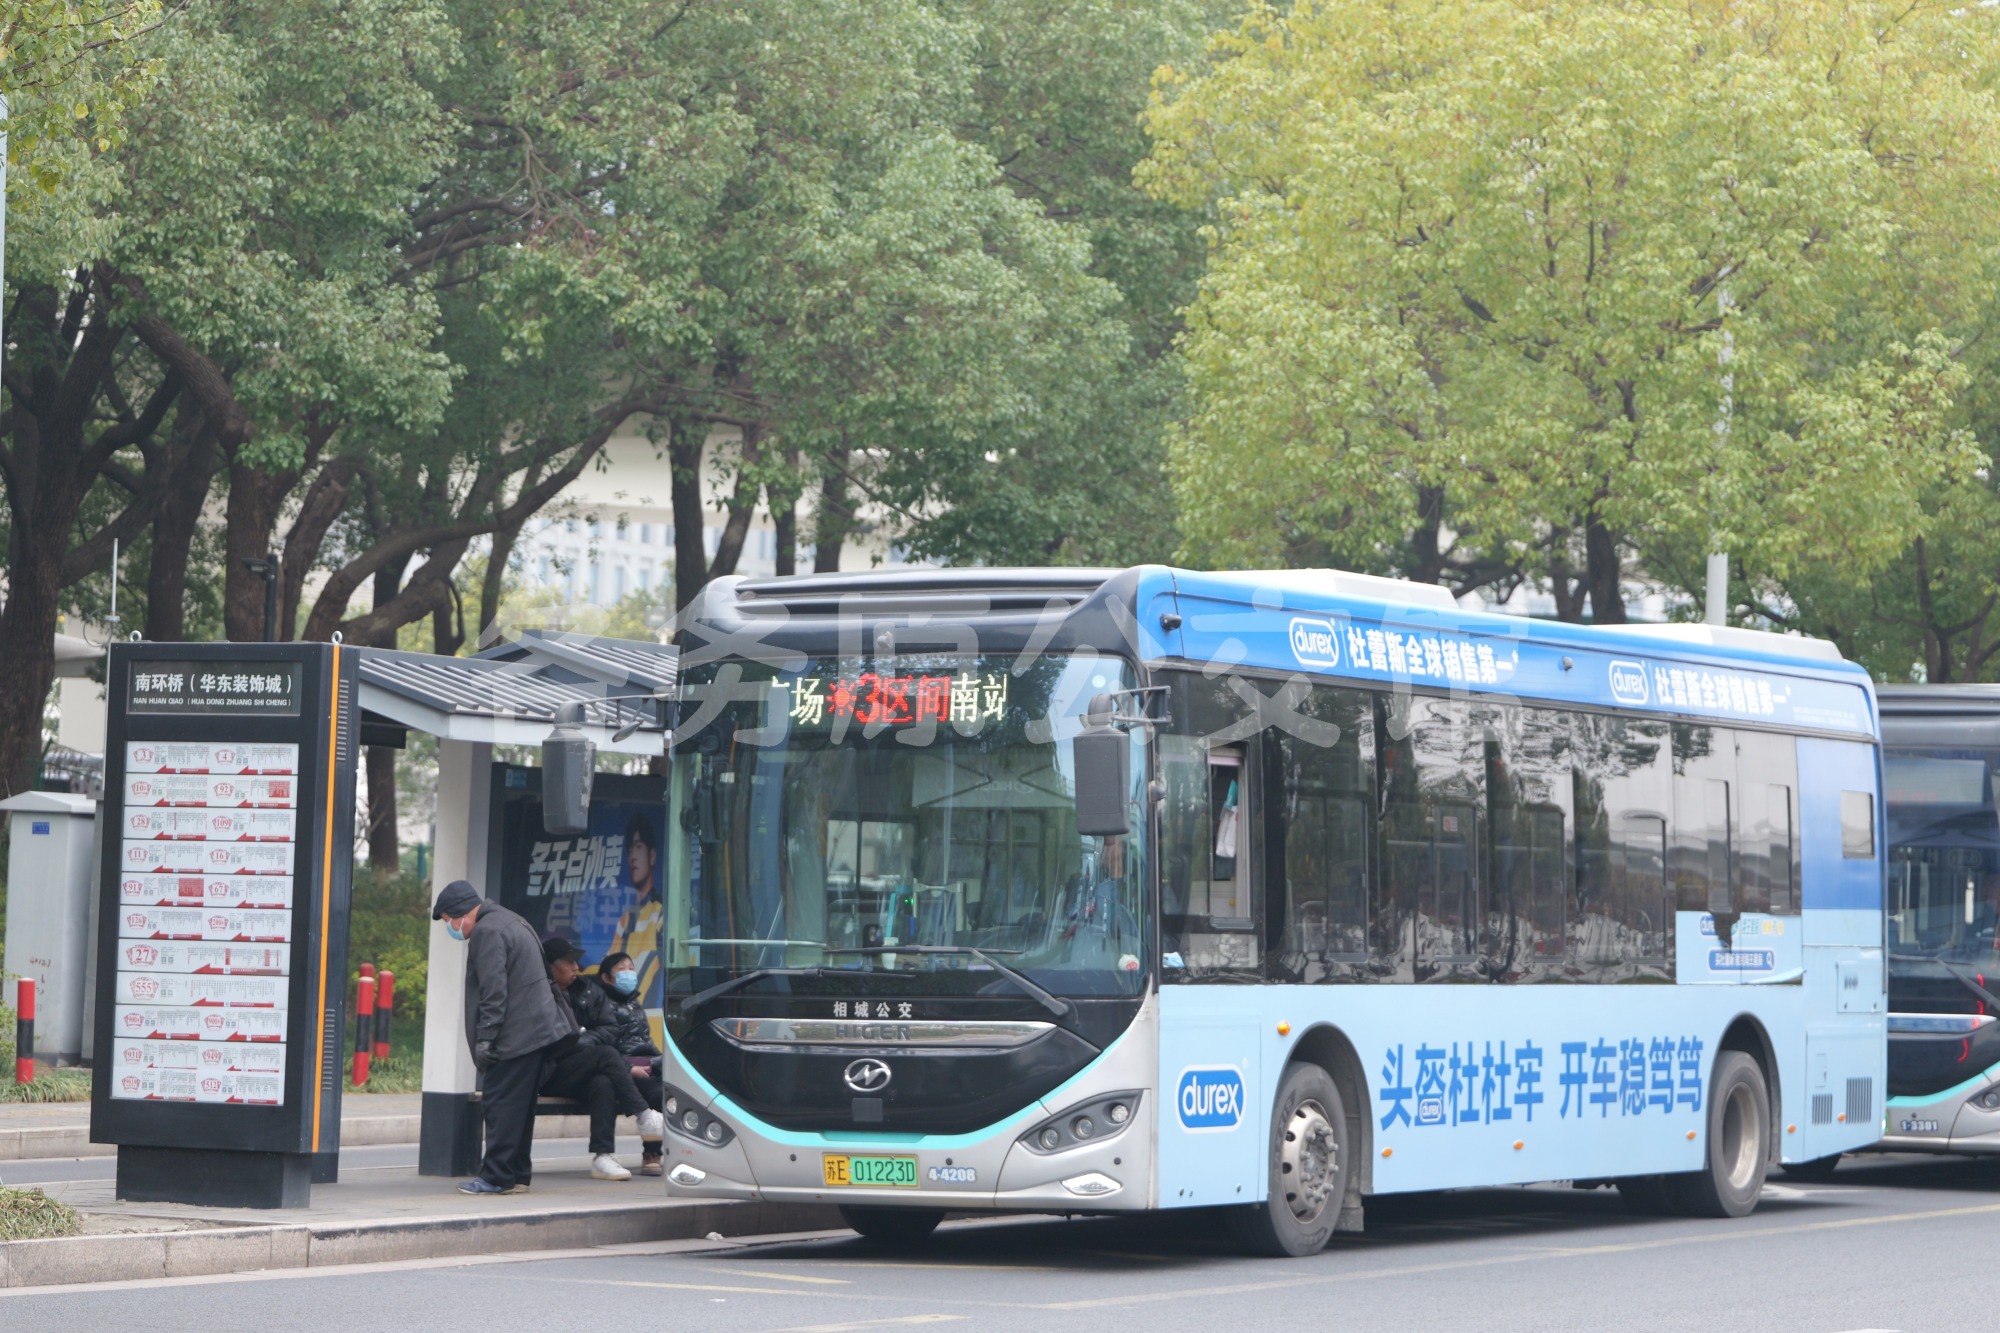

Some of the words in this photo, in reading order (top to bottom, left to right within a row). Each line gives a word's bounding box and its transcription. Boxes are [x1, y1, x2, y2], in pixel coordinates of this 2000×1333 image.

[1294, 624, 1335, 661] durex
[1613, 667, 1645, 696] durex
[133, 697, 147, 705] NAN
[206, 698, 225, 706] DONG
[226, 698, 252, 706] ZHUANG
[253, 698, 265, 706] SHI
[526, 834, 625, 897] 冬天点外卖
[135, 948, 150, 961] 27
[135, 983, 152, 993] 555
[833, 1001, 912, 1019] 相城公交
[835, 1023, 911, 1041] HIGER
[1558, 1034, 1704, 1121] 开车稳笃笃
[1182, 1075, 1242, 1121] durex
